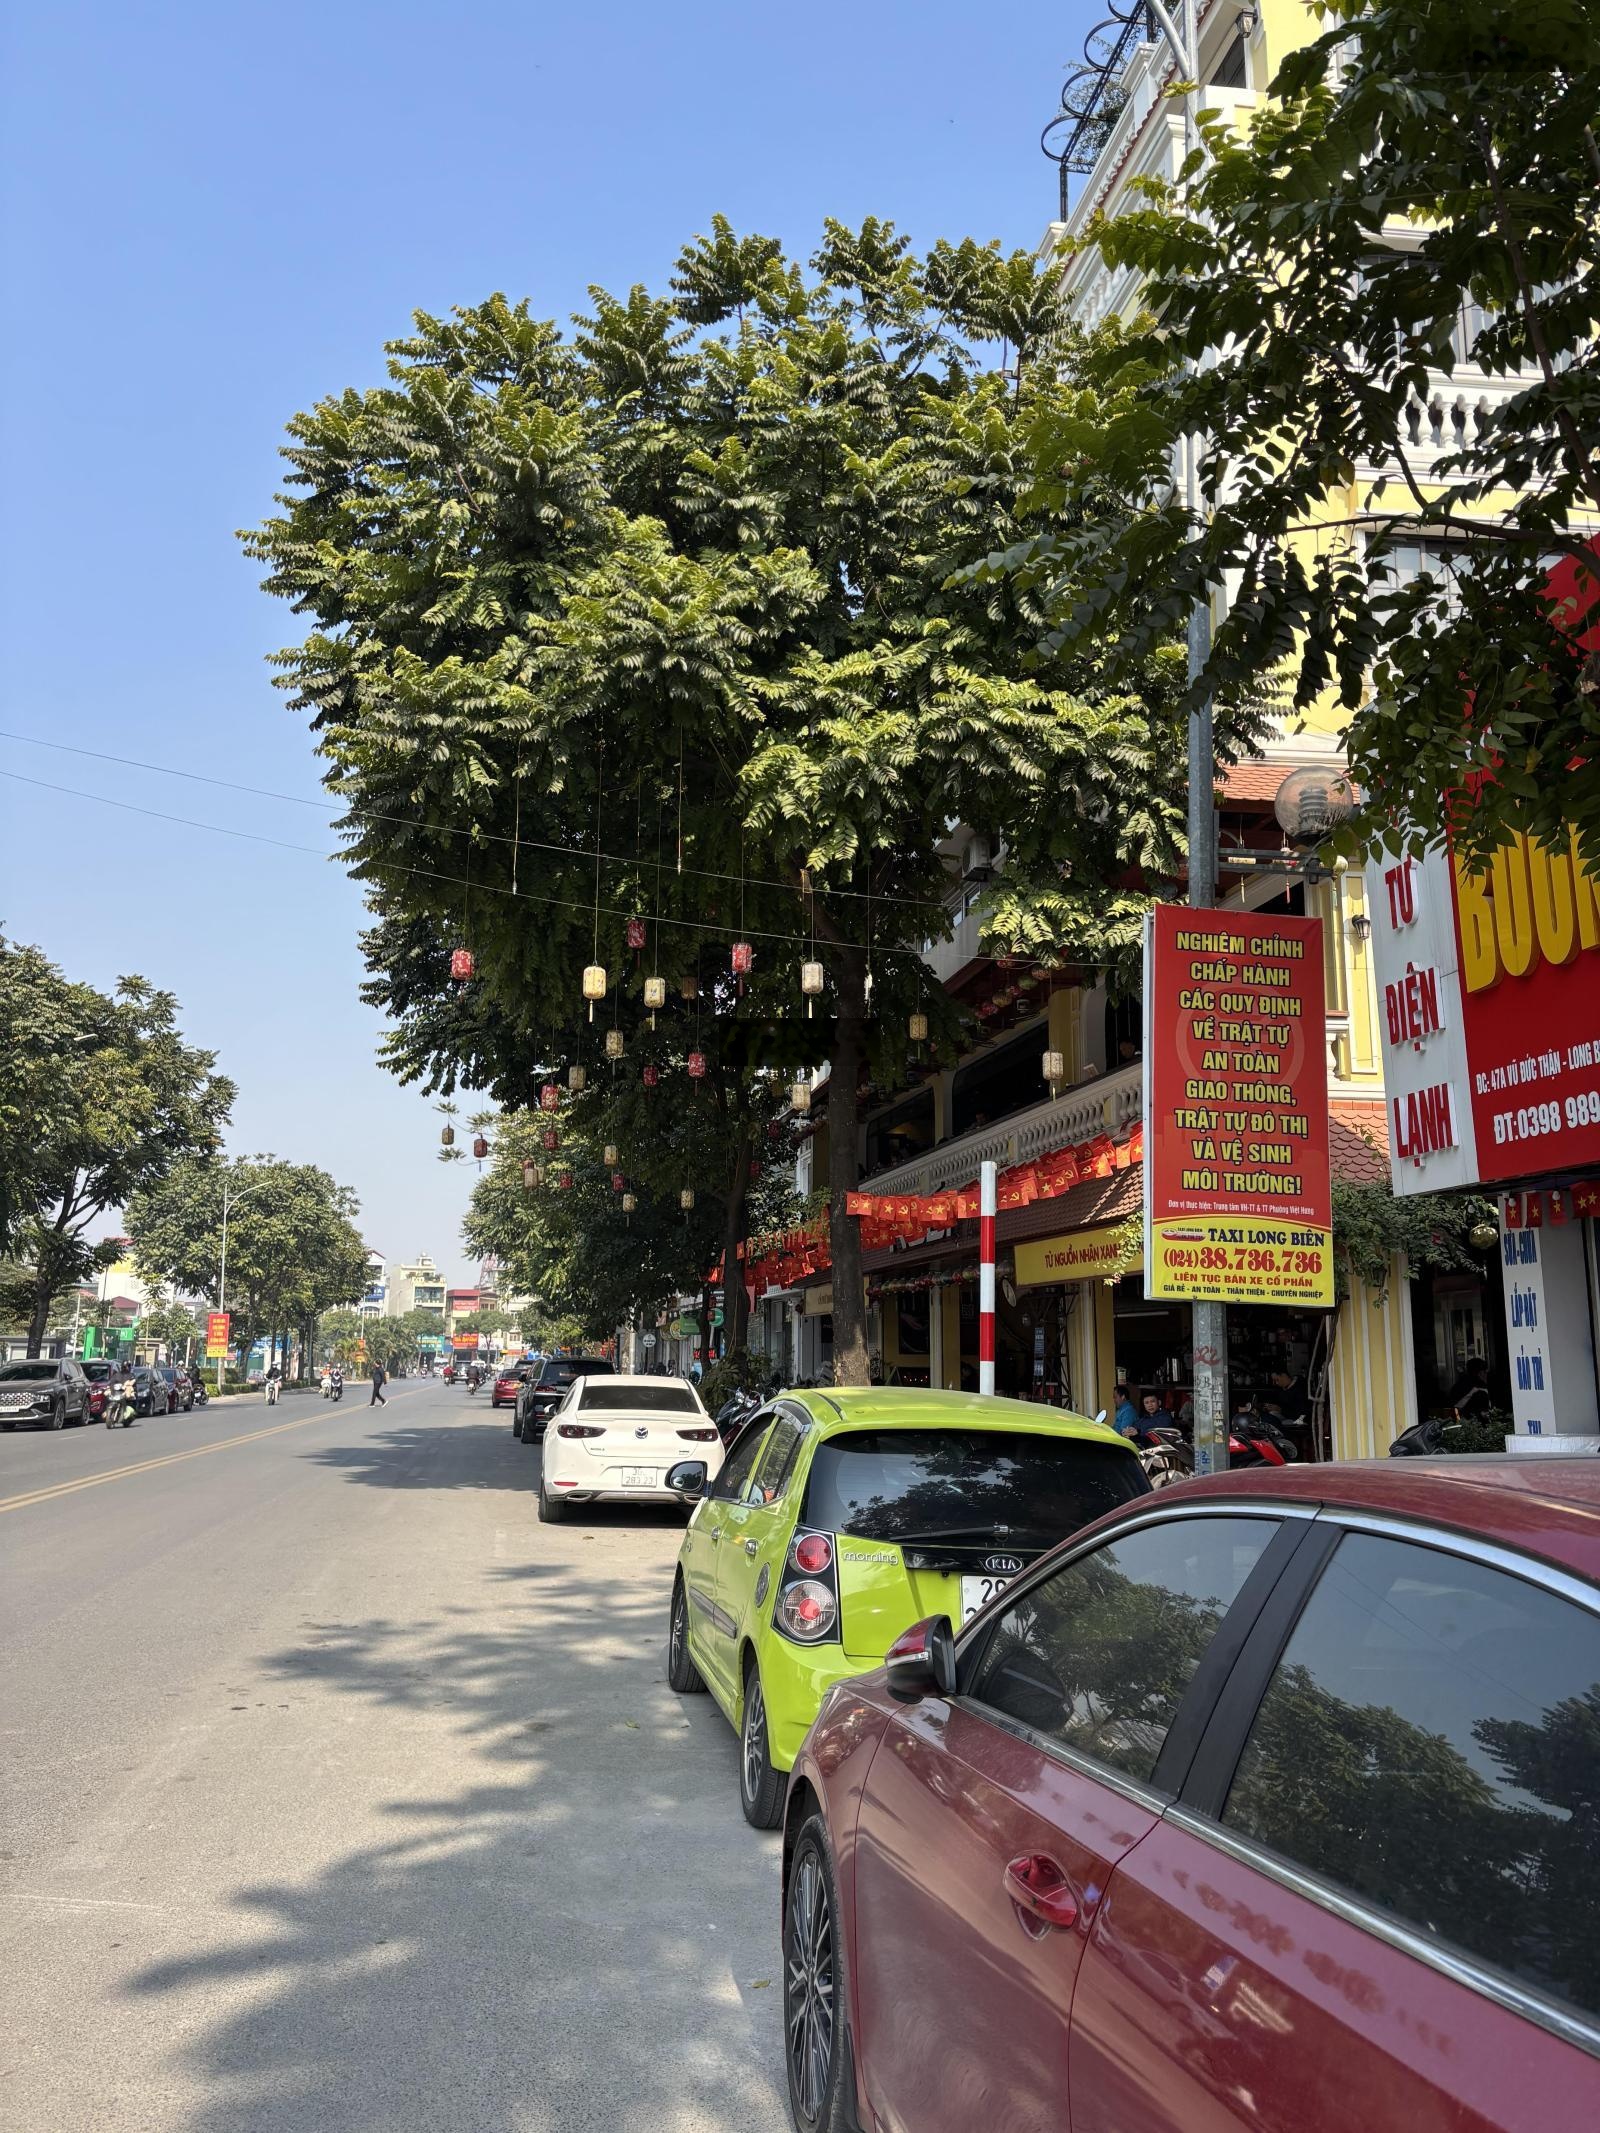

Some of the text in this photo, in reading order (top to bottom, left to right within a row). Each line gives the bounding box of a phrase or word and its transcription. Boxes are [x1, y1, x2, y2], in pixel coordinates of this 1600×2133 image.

[1176, 931, 1304, 959] NGHIÊM CHỈNH
[1190, 958, 1290, 986] CHẤP HÀNH
[1179, 988, 1302, 1019] CÁC QUY ĐỊNH
[1386, 962, 1440, 1051] ĐIỆN
[1191, 1015, 1291, 1048] VỀ TRẬT TỰ
[1201, 1050, 1280, 1075] AN TOÀN
[1491, 1067, 1507, 1090] 47A
[1506, 1059, 1519, 1087] VŨ
[1519, 1053, 1537, 1083] ĐỨC
[1537, 1048, 1561, 1080] THẬN
[1567, 1042, 1593, 1070] LONG
[1185, 1079, 1297, 1107] GIAO THÔNG,
[1174, 1105, 1308, 1139] TRẬT TỰ ĐÔ THỊ
[1393, 1083, 1454, 1167] LẠNH
[1191, 1136, 1293, 1165] VÀ VỆ SINH
[1182, 1166, 1302, 1195] MÔI TRƯỜNG!
[1213, 1202, 1228, 1212] Trung
[1208, 1228, 1325, 1247] TAXI LONG BIÊN
[1163, 1284, 1175, 1292] GIÁ
[1191, 1285, 1201, 1293] AN
[1203, 1285, 1220, 1294] TOÀN
[1227, 1287, 1244, 1295] THÂN
[1246, 1288, 1265, 1296] THIỆN
[1271, 1289, 1298, 1297] CHUYÊN
[1298, 1290, 1324, 1299] NGHIỆP
[1173, 1272, 1198, 1282] LIÊN
[1200, 1274, 1221, 1284] TỤC
[1224, 1274, 1246, 1284] BÁN
[1249, 1276, 1263, 1285] XE
[843, 1551, 899, 1566] morning
[991, 1558, 1017, 1570] KIA
